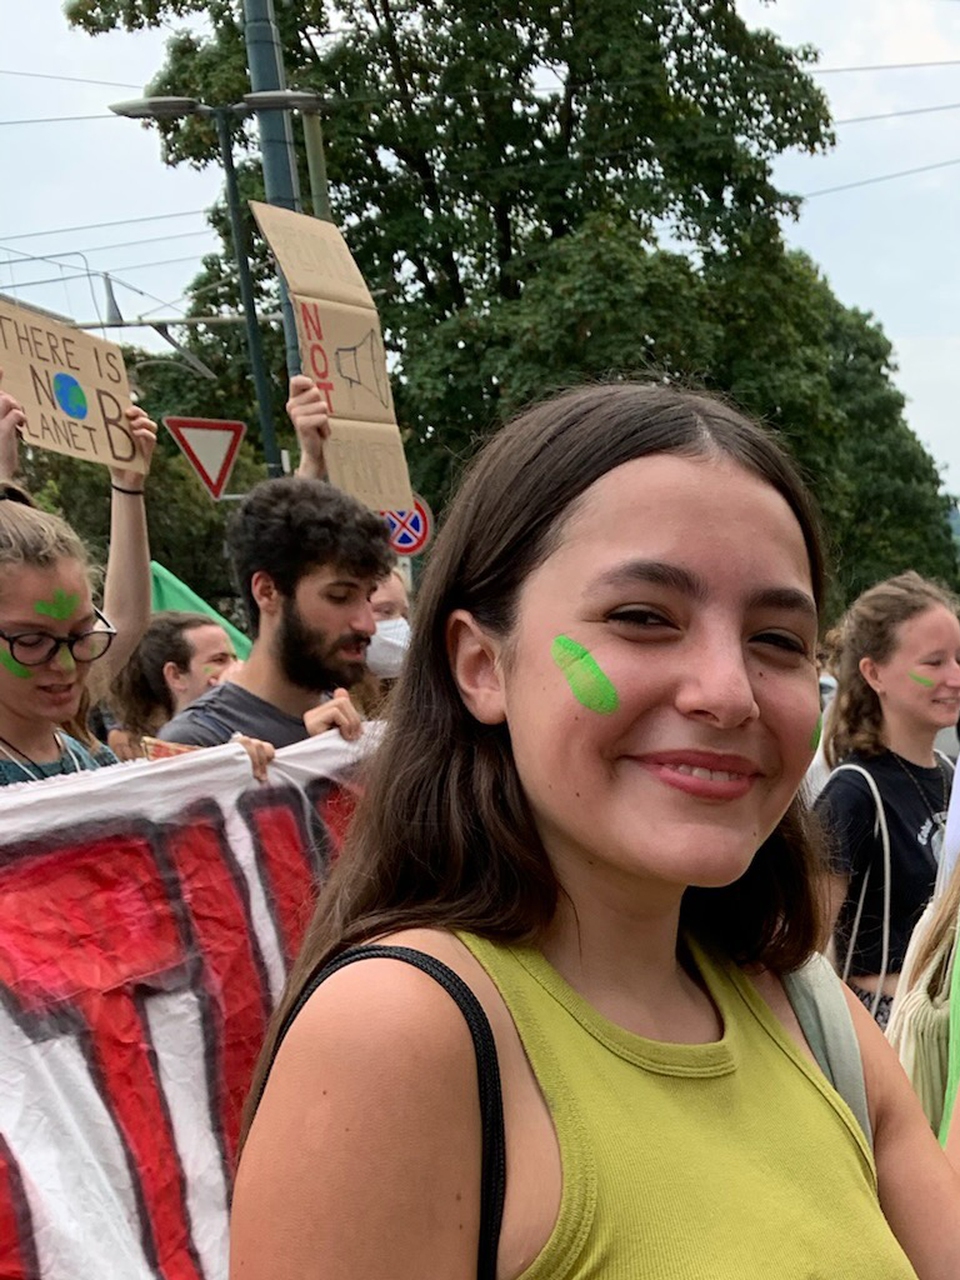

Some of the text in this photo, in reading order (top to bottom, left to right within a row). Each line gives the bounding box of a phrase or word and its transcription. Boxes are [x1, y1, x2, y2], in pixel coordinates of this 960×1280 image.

[0, 315, 122, 384] THERE IS
[301, 302, 335, 415] NOT
[22, 388, 136, 462] LANET B
